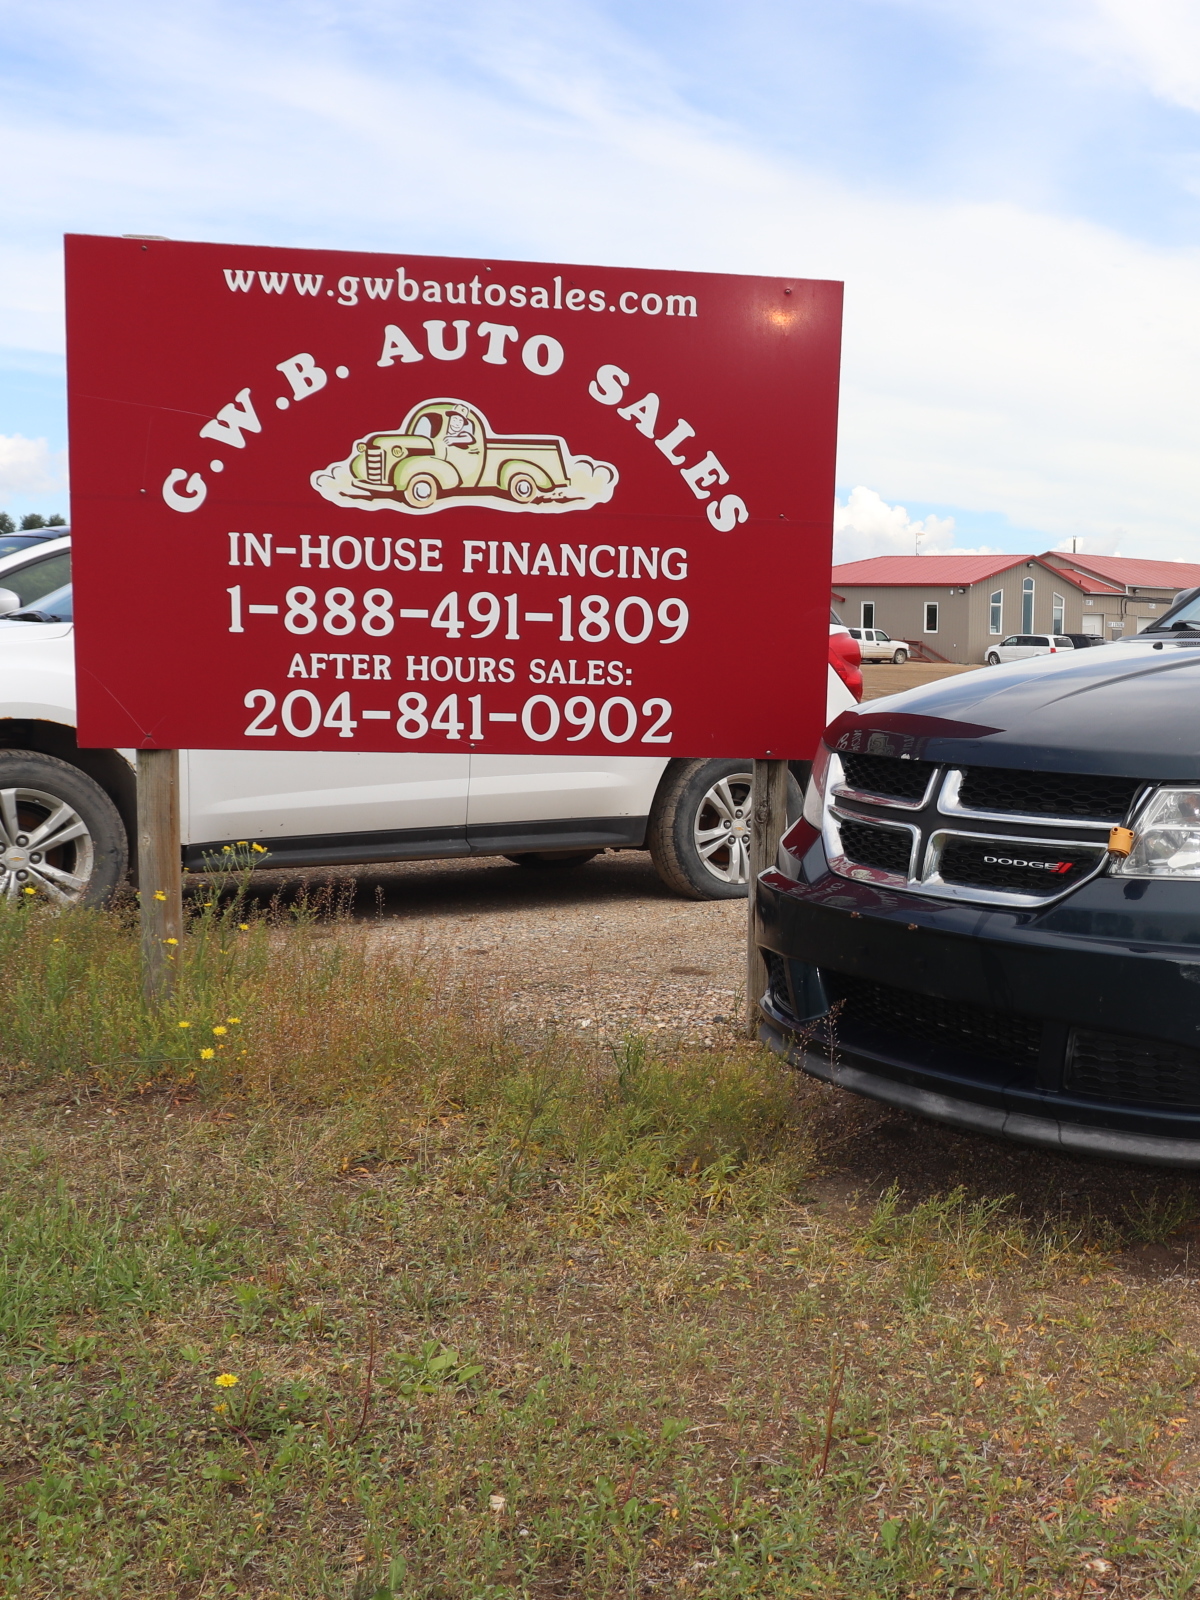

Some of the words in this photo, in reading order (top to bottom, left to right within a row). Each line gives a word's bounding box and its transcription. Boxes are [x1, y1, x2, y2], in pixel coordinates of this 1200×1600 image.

[222, 266, 698, 319] www.gwbautosales.com
[162, 350, 350, 514] G.W.B.
[376, 319, 565, 377] AUTO
[588, 364, 749, 534] SALES
[227, 531, 443, 573] IN-HOUSE
[462, 540, 688, 581] FINANCING
[226, 584, 689, 645] 1-888-491-1809
[286, 652, 392, 682] AFTER
[406, 655, 516, 684] HOURS
[528, 658, 633, 687] SALES:
[243, 688, 674, 745] 204-841-0902
[983, 855, 1060, 871] DODGE
